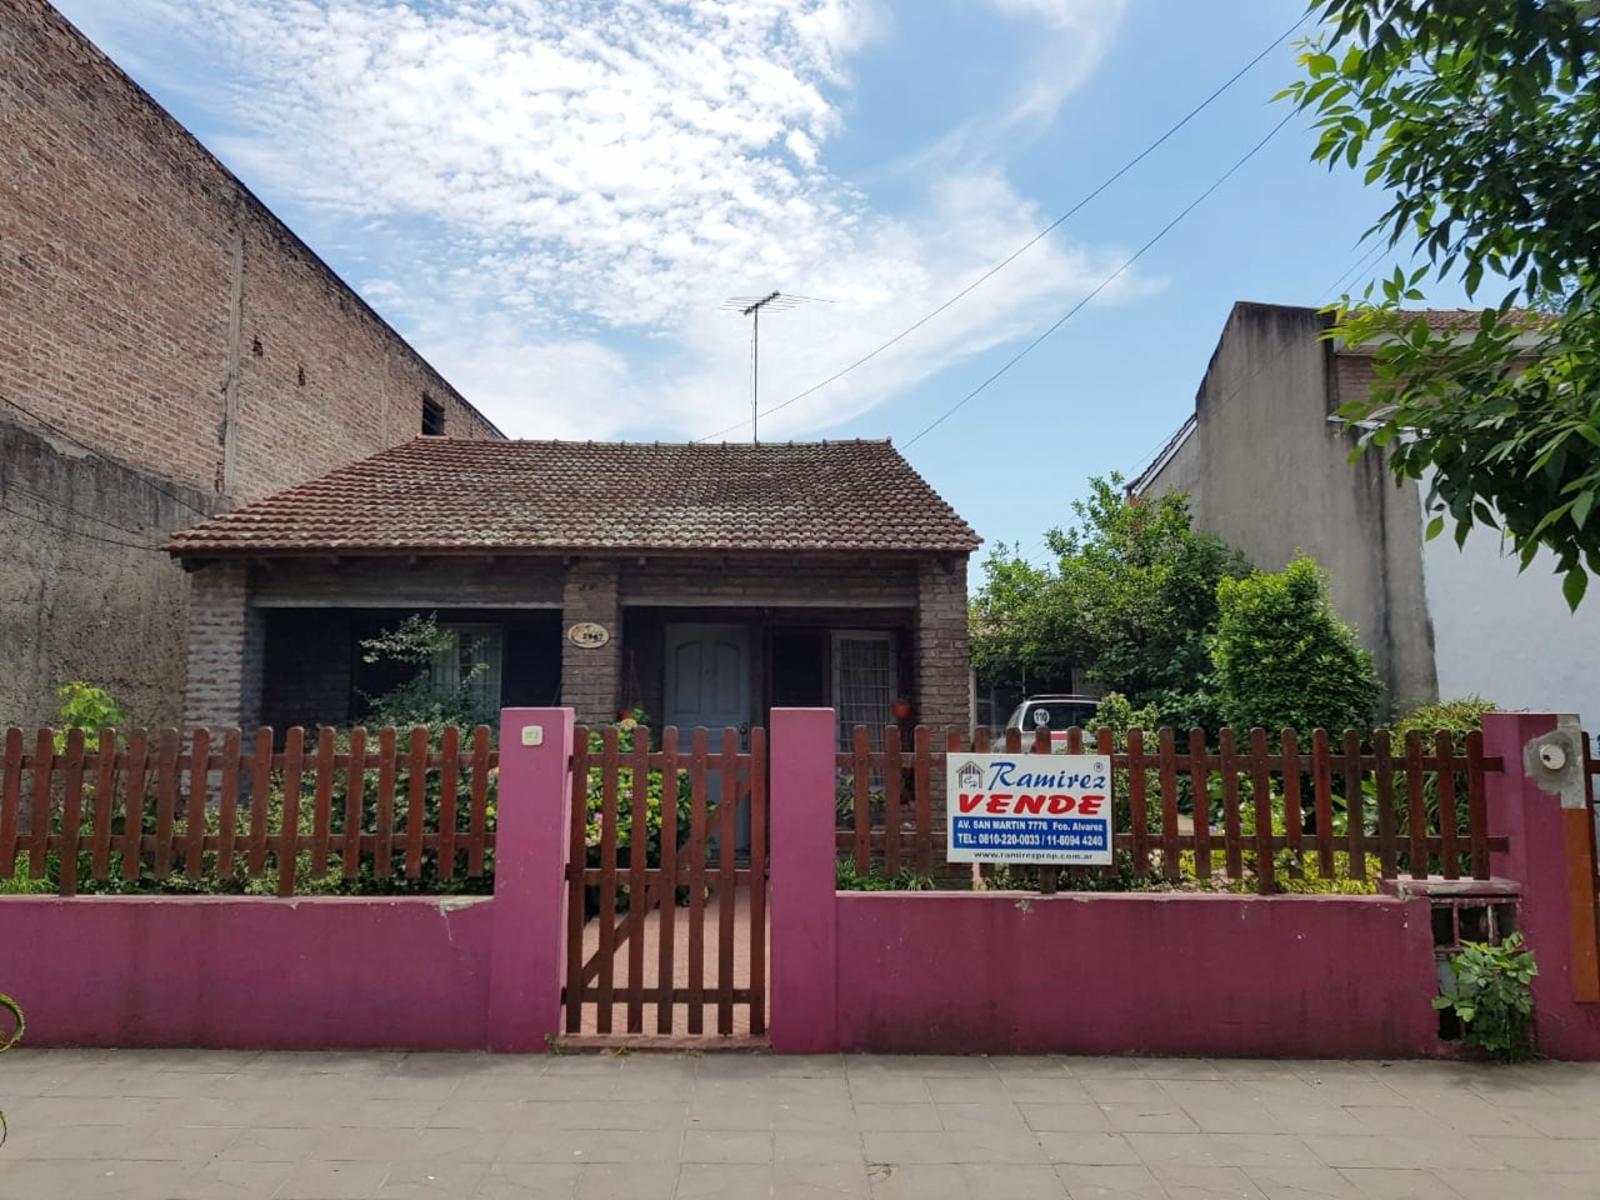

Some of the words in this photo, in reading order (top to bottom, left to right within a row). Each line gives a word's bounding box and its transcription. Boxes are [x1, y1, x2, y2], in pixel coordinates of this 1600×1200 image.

[988, 762, 1106, 791] Ramirez
[958, 793, 1105, 815] VENDE
[957, 820, 971, 830] AV.
[973, 821, 991, 830] SAN
[992, 821, 1026, 830] MARTIN
[1053, 822, 1070, 831] Fco.
[1072, 823, 1104, 832] Alvarez
[957, 833, 977, 845] TEL:
